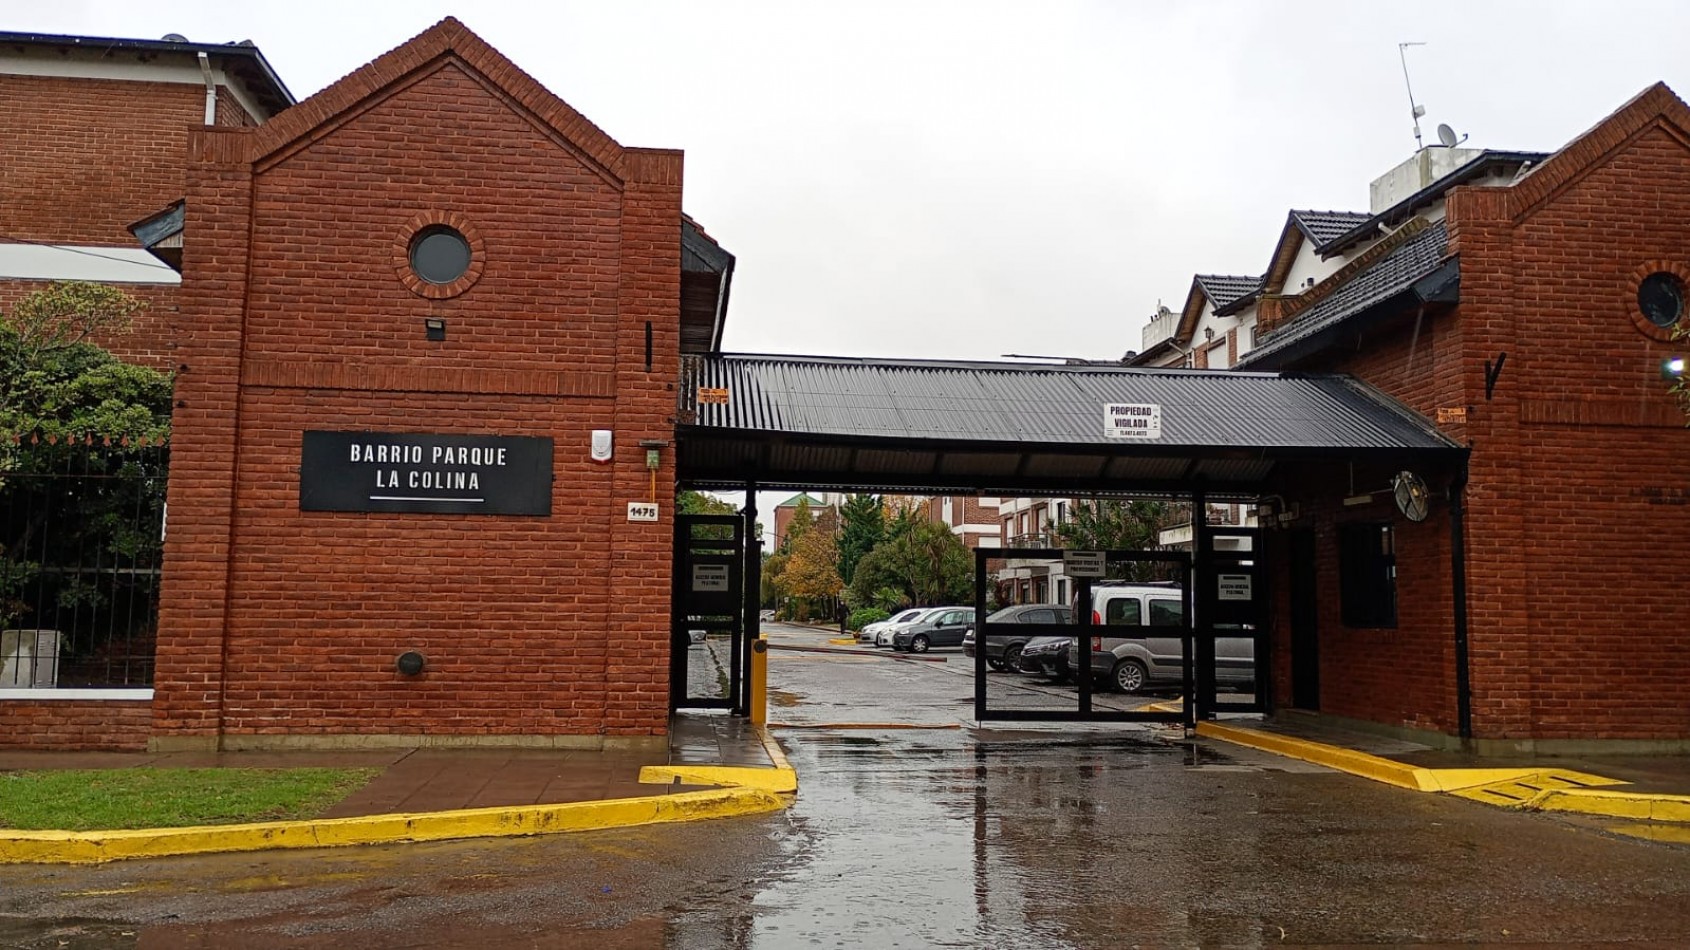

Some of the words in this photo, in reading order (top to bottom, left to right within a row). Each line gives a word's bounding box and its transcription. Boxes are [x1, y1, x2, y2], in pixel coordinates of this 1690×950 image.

[1110, 406, 1152, 416] PROPIEDAD
[1114, 418, 1147, 428] VIGILADA
[350, 444, 422, 463] BARRIO
[432, 446, 507, 466] PARQUE
[376, 470, 399, 488] LA
[409, 471, 480, 490] COLINA
[630, 507, 655, 517] 1475
